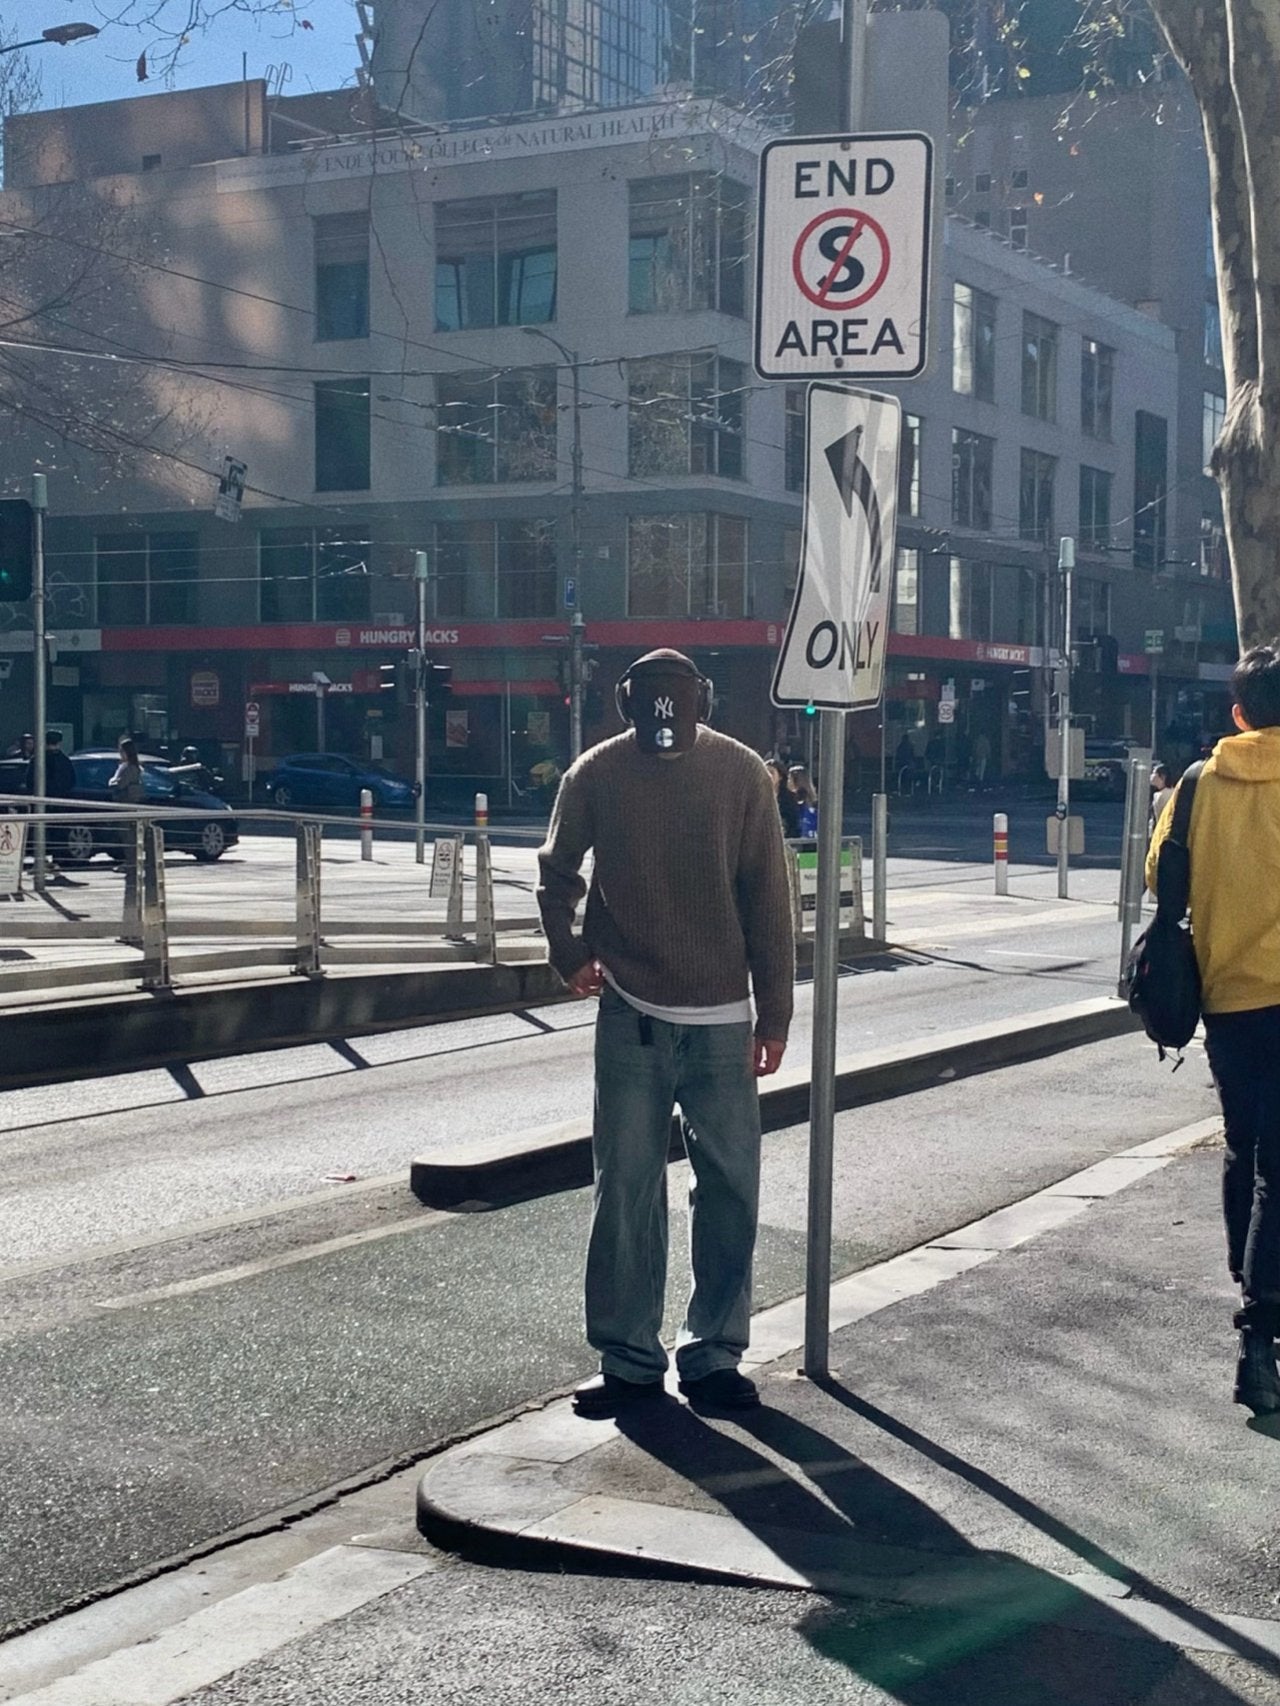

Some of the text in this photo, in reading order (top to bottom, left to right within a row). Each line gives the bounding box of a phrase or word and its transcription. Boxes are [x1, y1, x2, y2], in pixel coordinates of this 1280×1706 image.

[418, 137, 494, 160] OLLEGE
[516, 124, 597, 148] NATURAL
[600, 113, 676, 138] HEALTH
[795, 158, 895, 199] END
[774, 318, 905, 358] AREA
[360, 630, 416, 644] HUNGRY
[806, 619, 880, 675] ONLY
[289, 683, 320, 692] HUNGR
